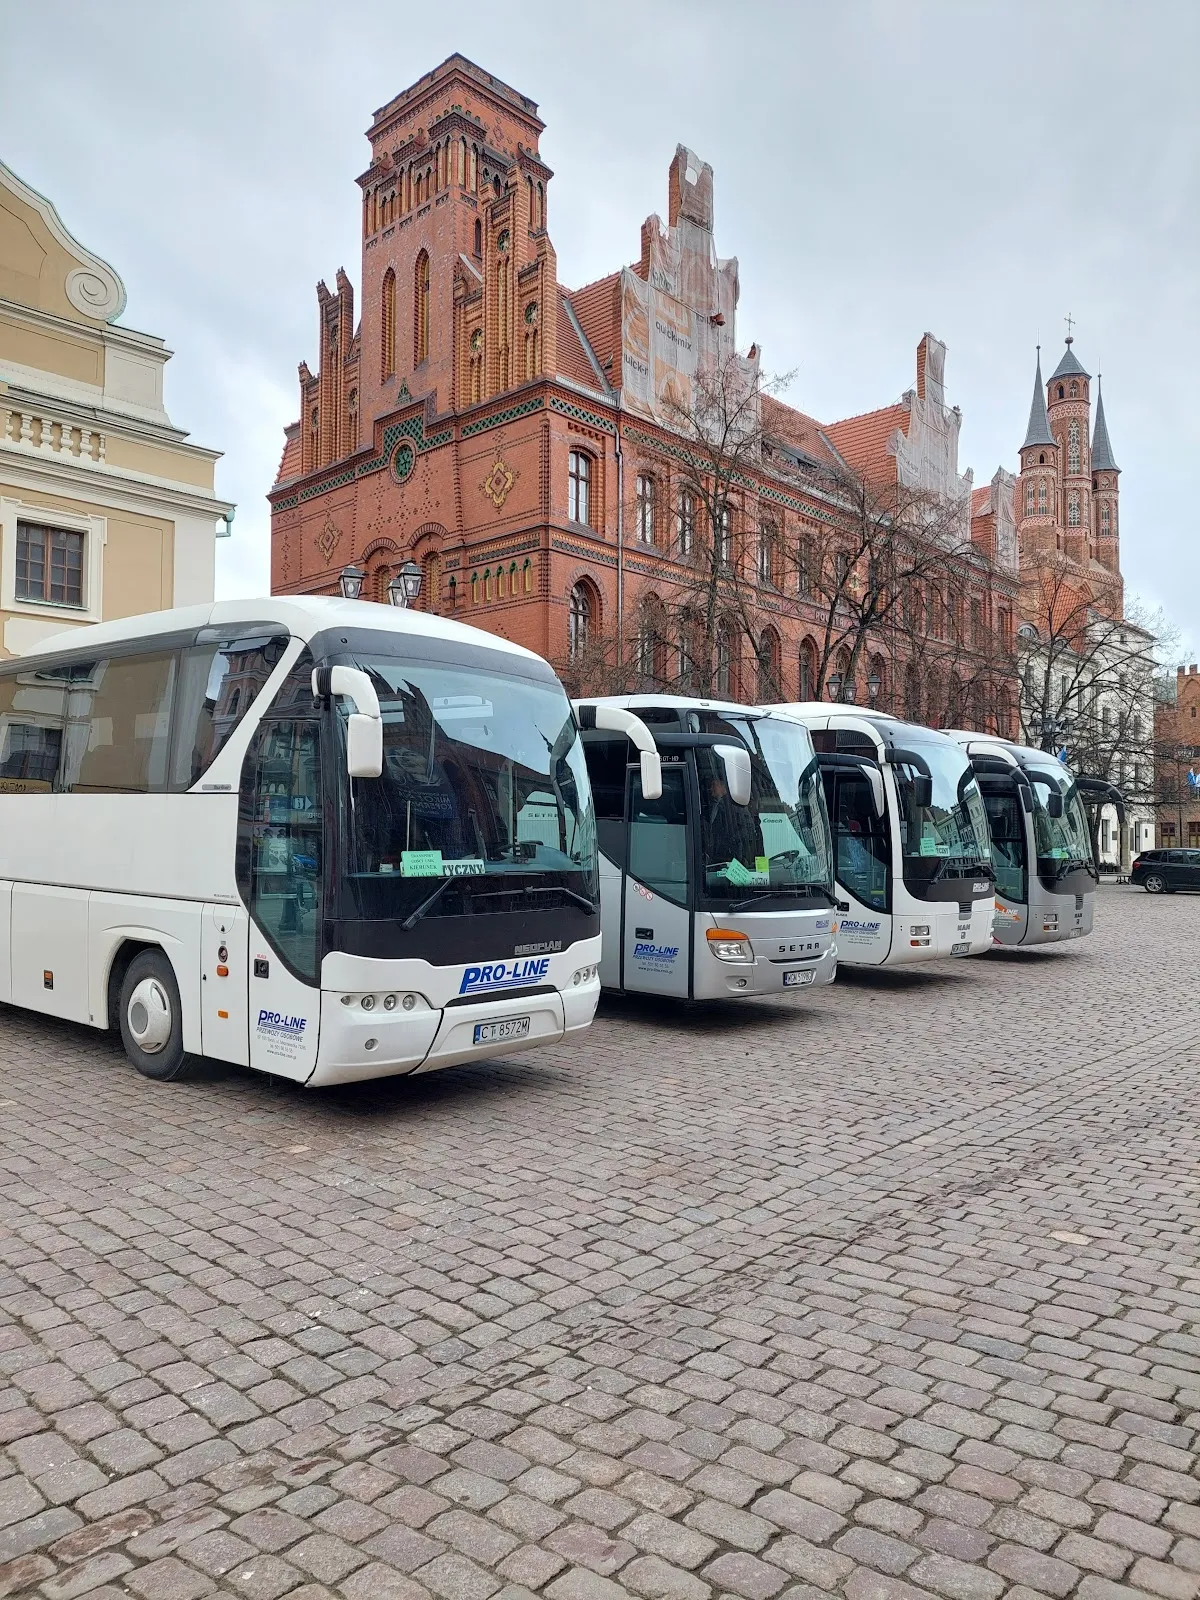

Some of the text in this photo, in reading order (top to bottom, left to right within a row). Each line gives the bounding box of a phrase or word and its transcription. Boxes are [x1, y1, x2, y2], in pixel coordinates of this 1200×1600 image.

[655, 320, 692, 352] quick-mix
[840, 920, 881, 929] PRO-LINE
[957, 923, 970, 931] MAN
[514, 940, 562, 955] NEOPLAN
[633, 943, 679, 956] PRO-LINE
[778, 942, 820, 953] SETRA
[459, 958, 551, 995] PRO-LINE
[258, 1010, 306, 1030] PRO-LINE
[256, 1026, 279, 1037] PRZEWOZY
[279, 1032, 304, 1043] OSOBOWE
[481, 1020, 529, 1040] CT 8572M
